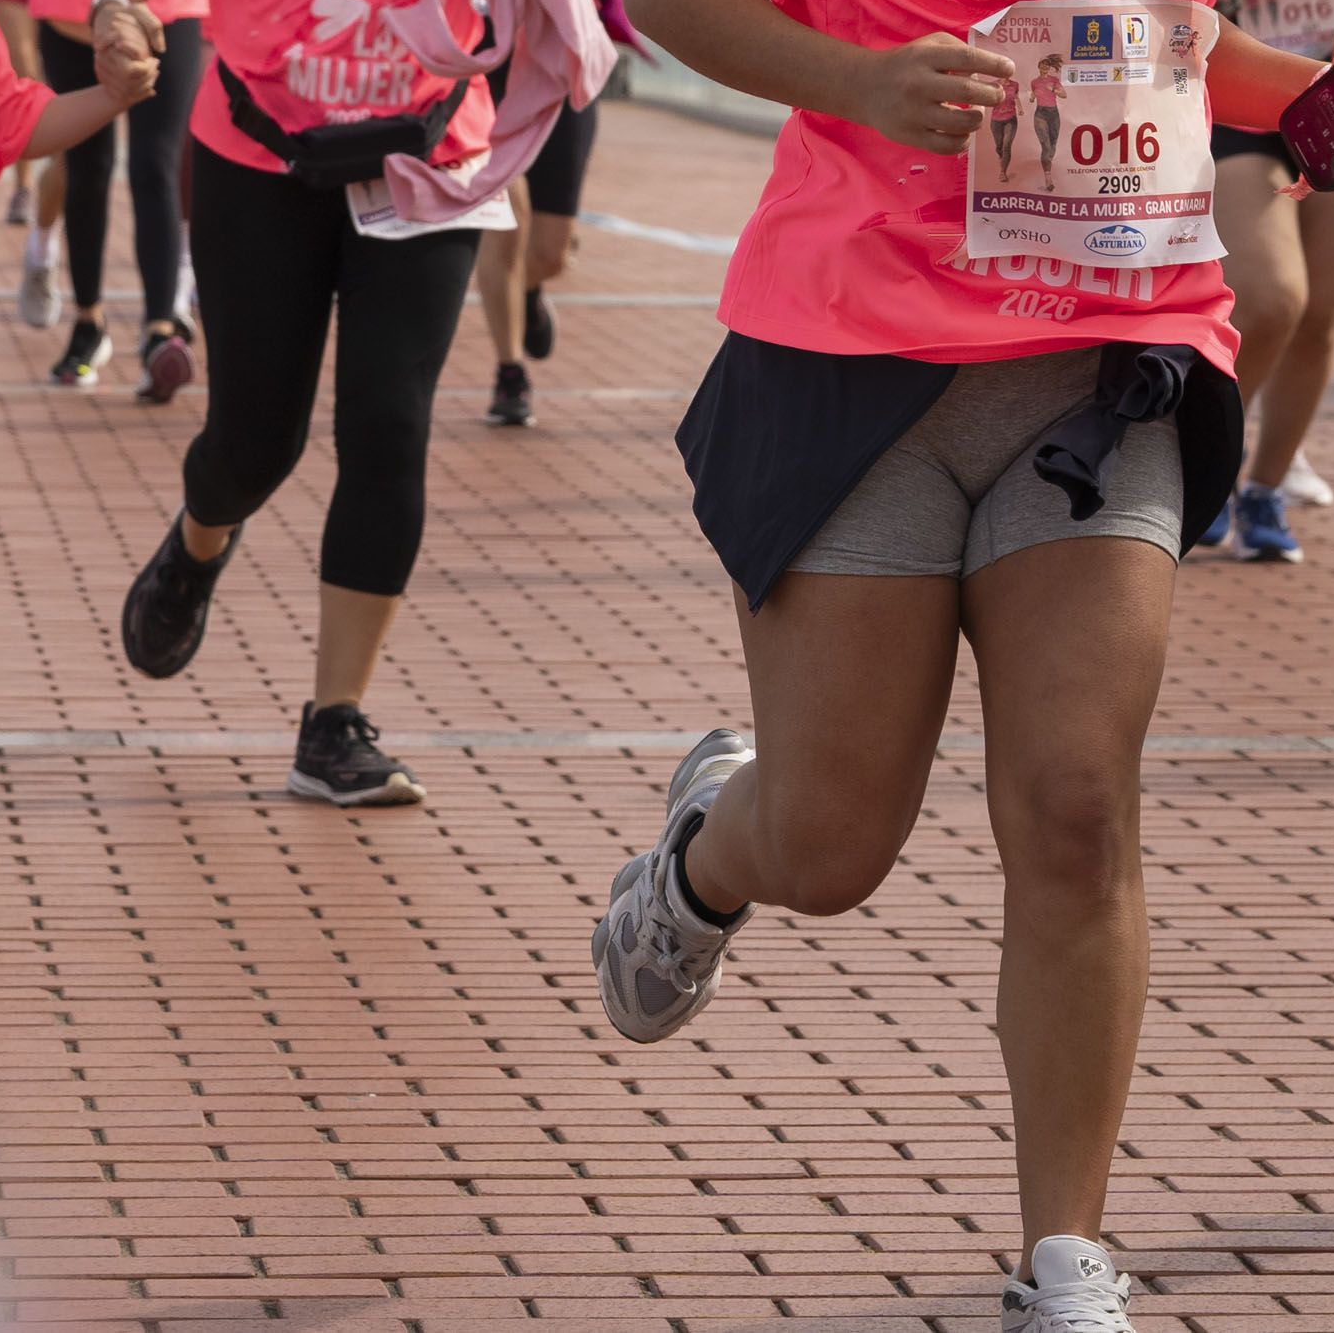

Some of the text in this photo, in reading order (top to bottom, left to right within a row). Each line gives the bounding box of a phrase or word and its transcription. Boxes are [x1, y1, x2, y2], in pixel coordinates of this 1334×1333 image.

[1010, 17, 1052, 27] DORSAL
[996, 27, 1052, 44] SUMA
[287, 56, 415, 107] MUJER
[1070, 122, 1160, 166] 016
[1098, 175, 1141, 194] 2909
[981, 196, 1206, 217] CARRERA DE LA MUJER GRAN CANARIA
[998, 228, 1051, 245] OYSHO
[1089, 236, 1143, 249] ASTURIANA
[997, 288, 1078, 322] 2026
